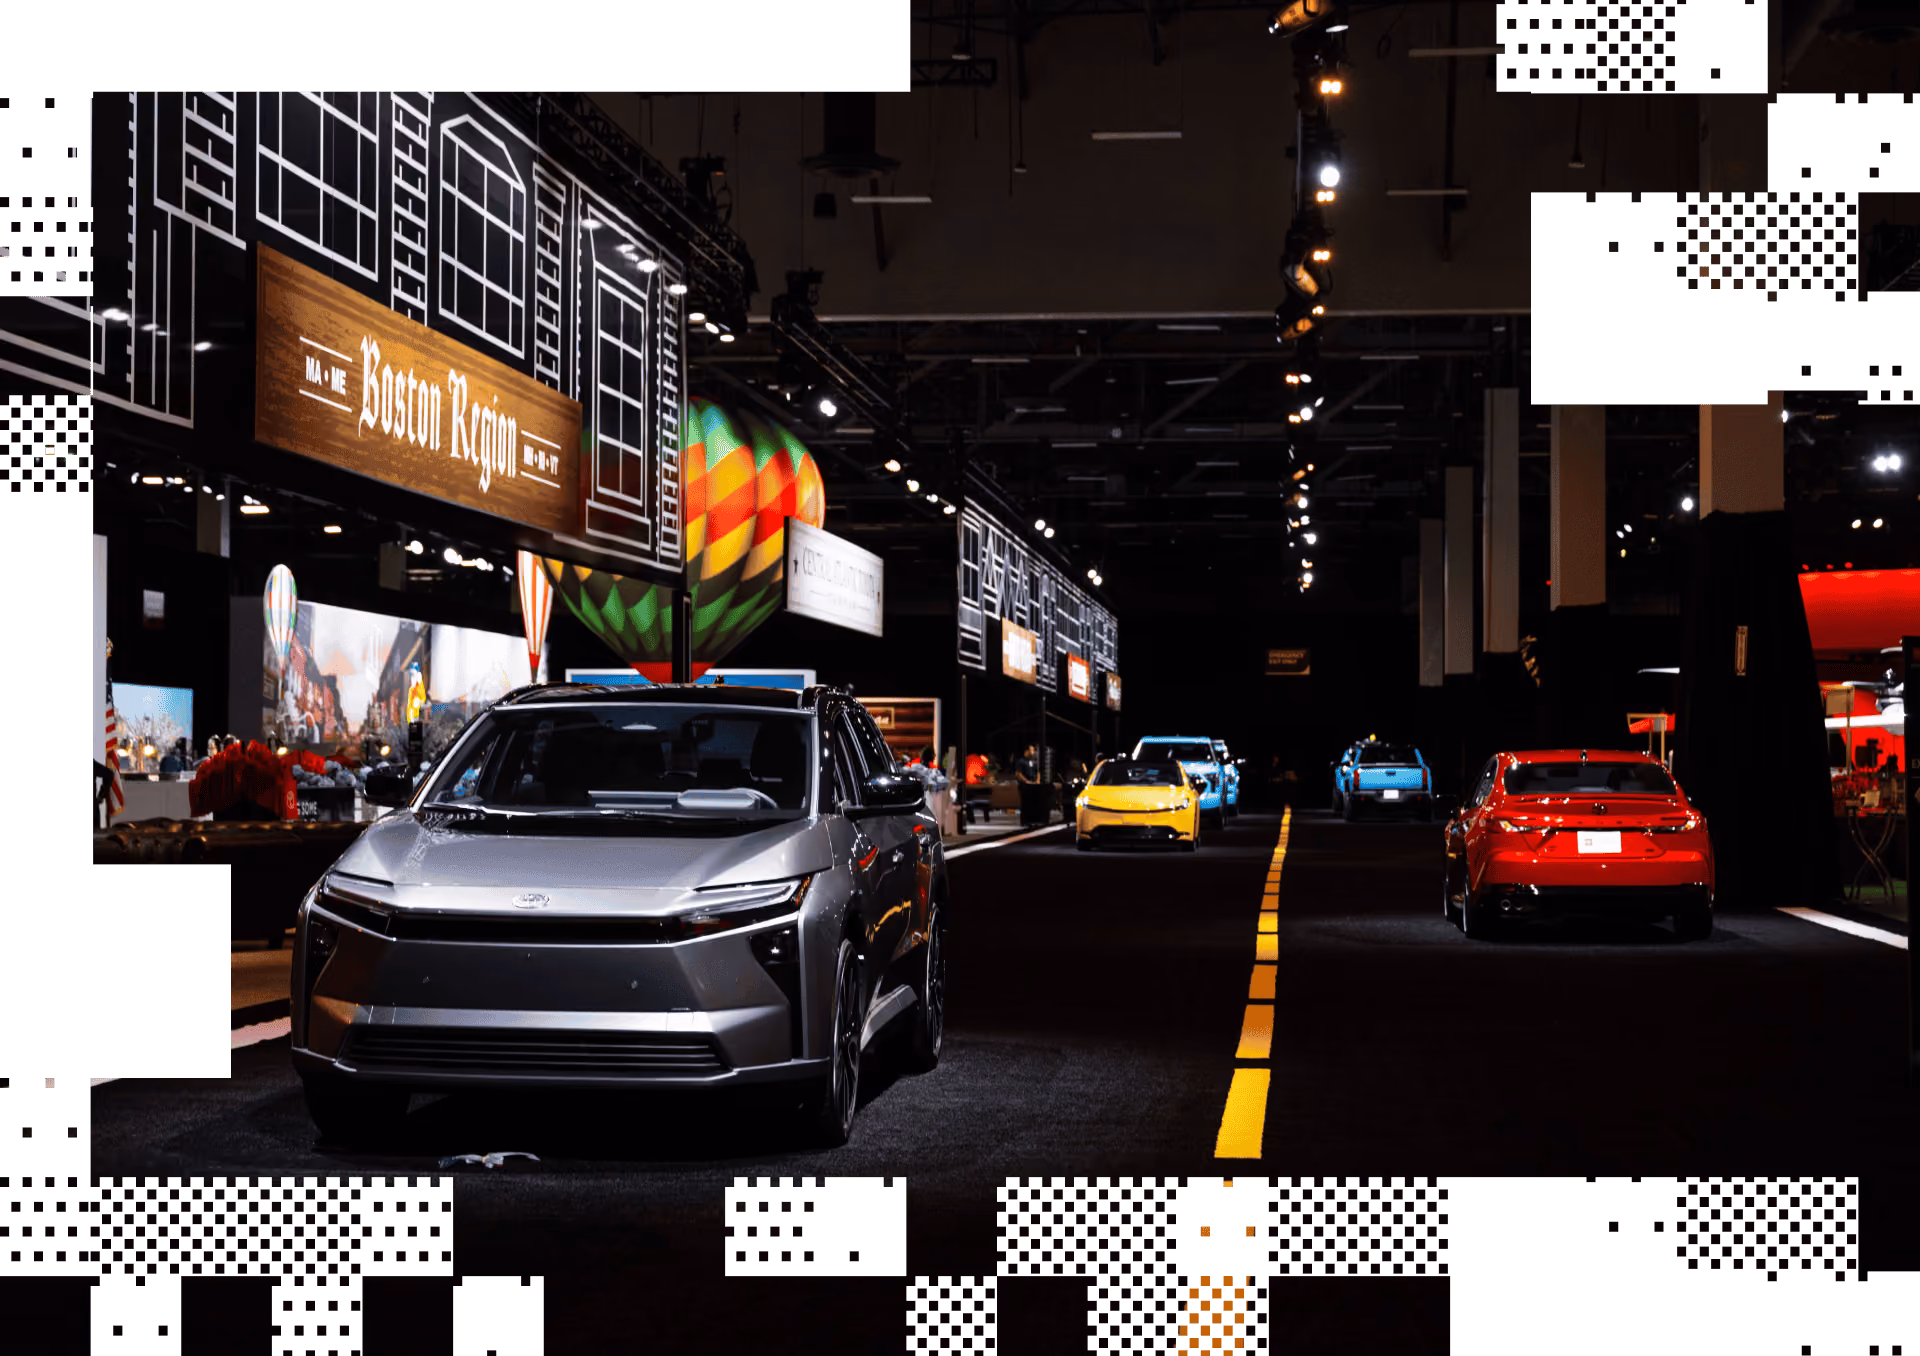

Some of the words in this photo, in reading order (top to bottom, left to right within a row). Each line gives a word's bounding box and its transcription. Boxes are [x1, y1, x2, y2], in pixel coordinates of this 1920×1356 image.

[306, 355, 322, 385] MA
[331, 366, 346, 395] ME
[359, 334, 441, 452] Boston
[448, 368, 517, 493] Region
[301, 801, 317, 815] SOME
